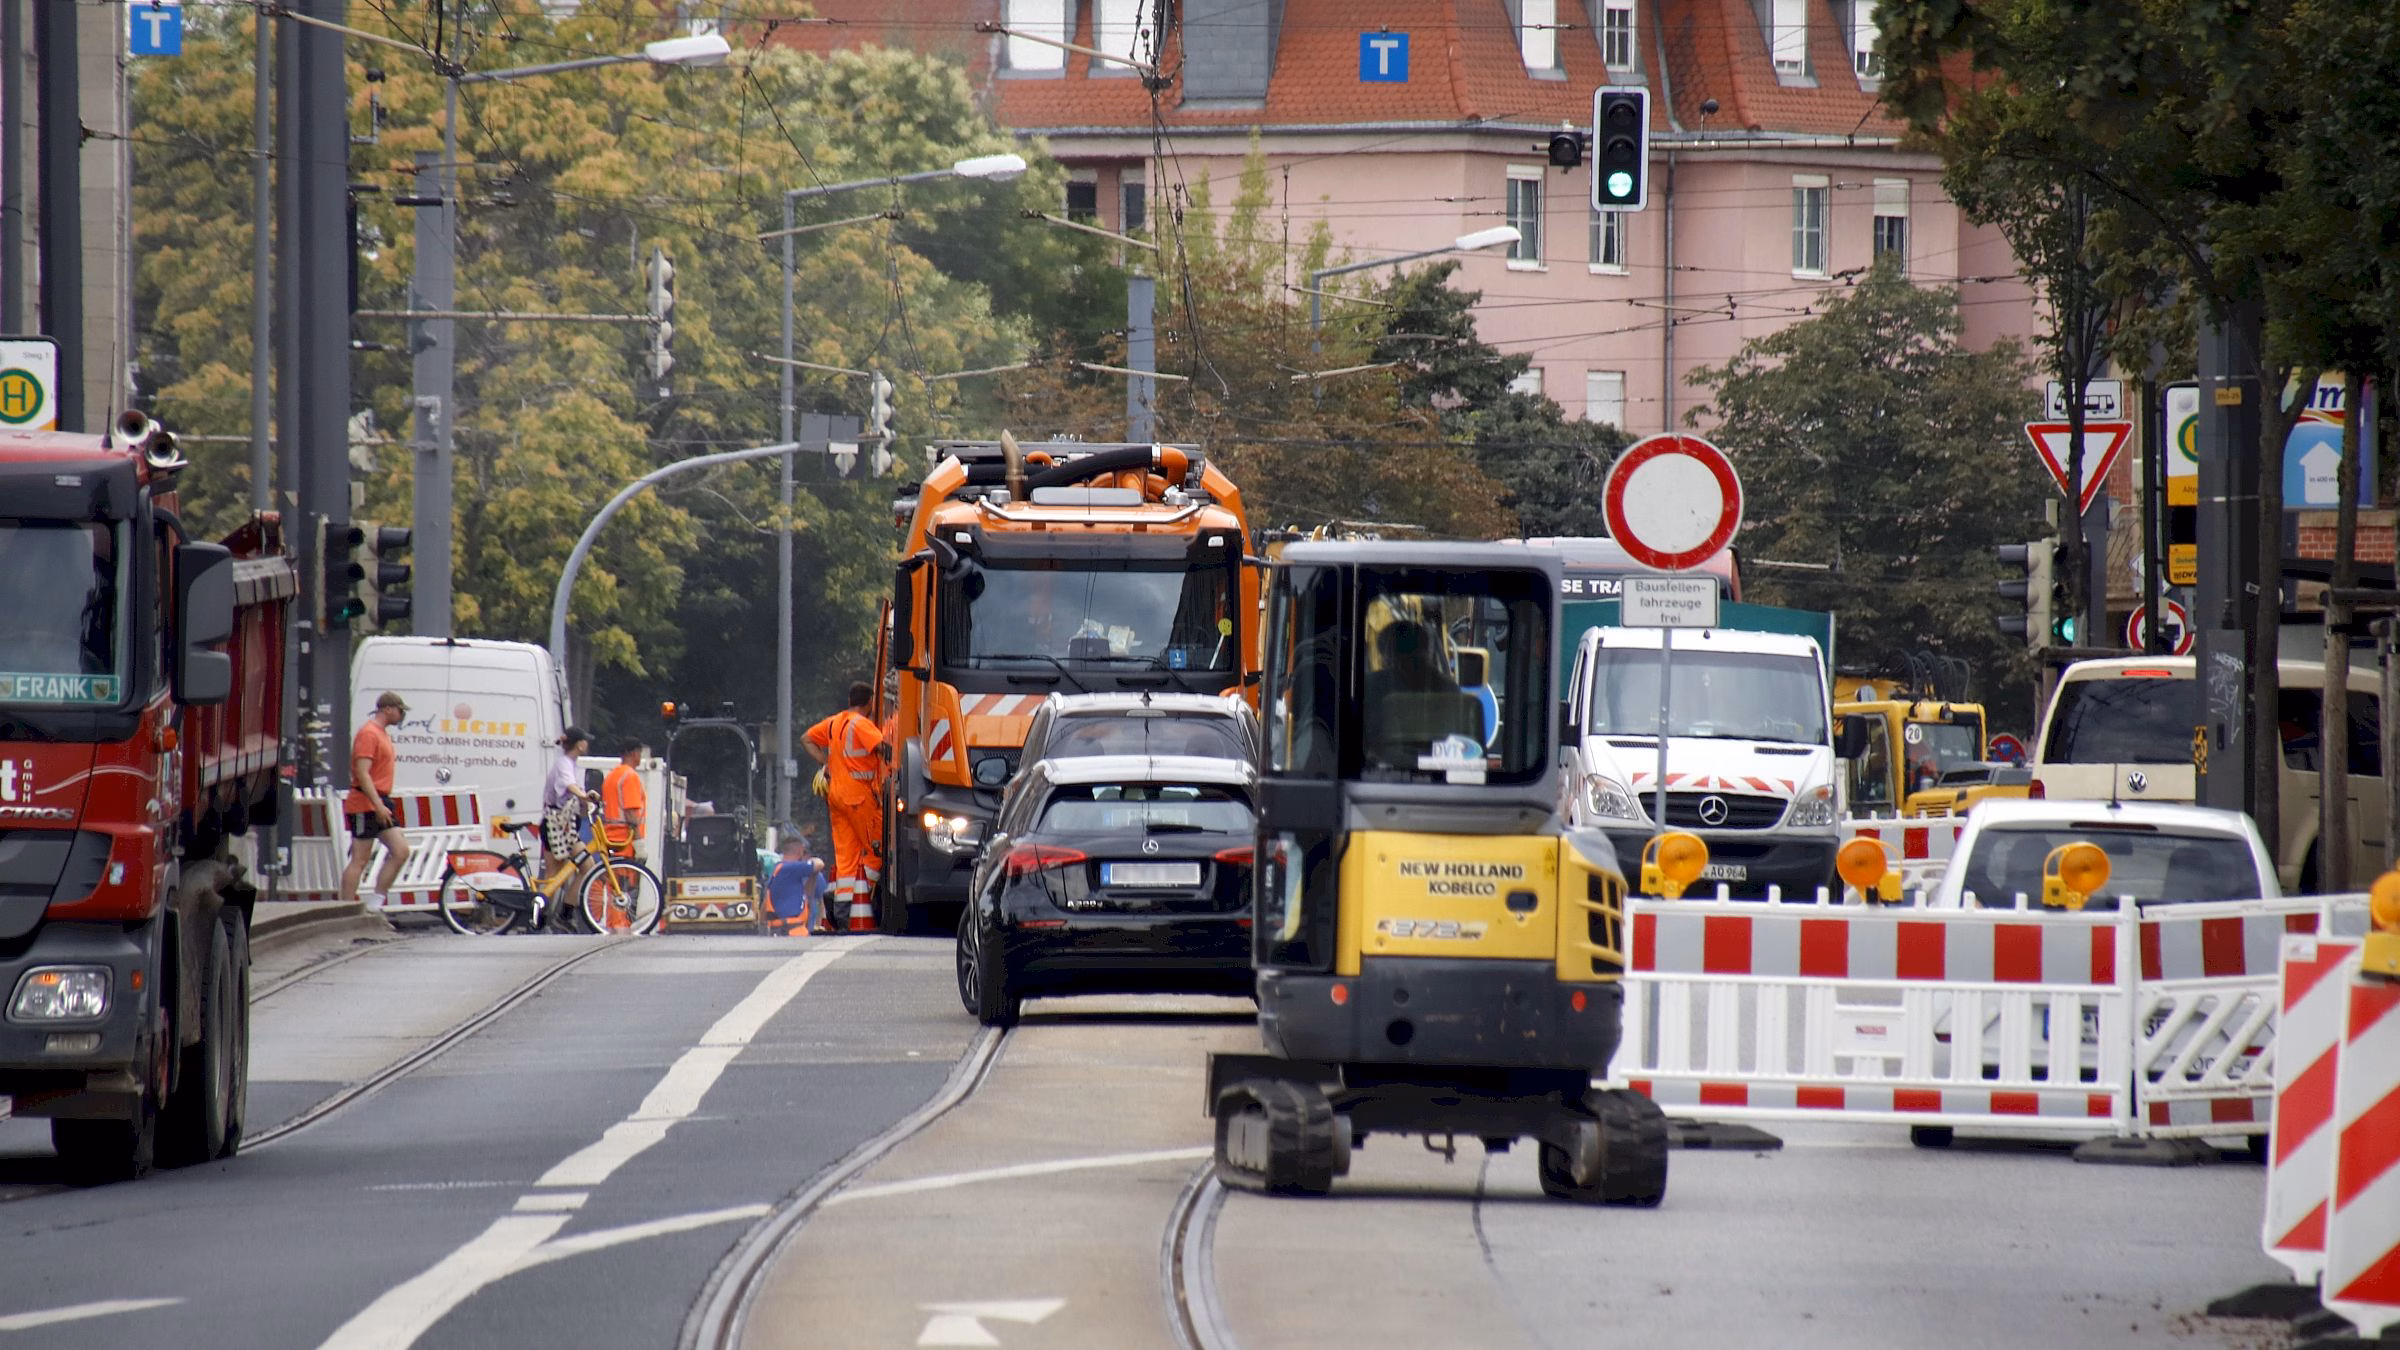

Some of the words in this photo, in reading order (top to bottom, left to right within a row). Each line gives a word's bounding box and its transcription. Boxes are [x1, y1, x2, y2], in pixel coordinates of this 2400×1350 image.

[140, 12, 171, 48] T
[1370, 40, 1398, 74] T
[3, 381, 26, 411] H
[1635, 580, 1707, 592] Baustellen-
[1640, 596, 1702, 610] fahrzeuge
[1660, 612, 1681, 624] frei
[16, 676, 88, 699] FRANK
[1908, 727, 1920, 740] 20
[473, 738, 525, 749] DRESDEN
[1400, 863, 1440, 876] NEW
[1444, 864, 1523, 878] HOLLAND
[1429, 880, 1496, 896] KOBELCO
